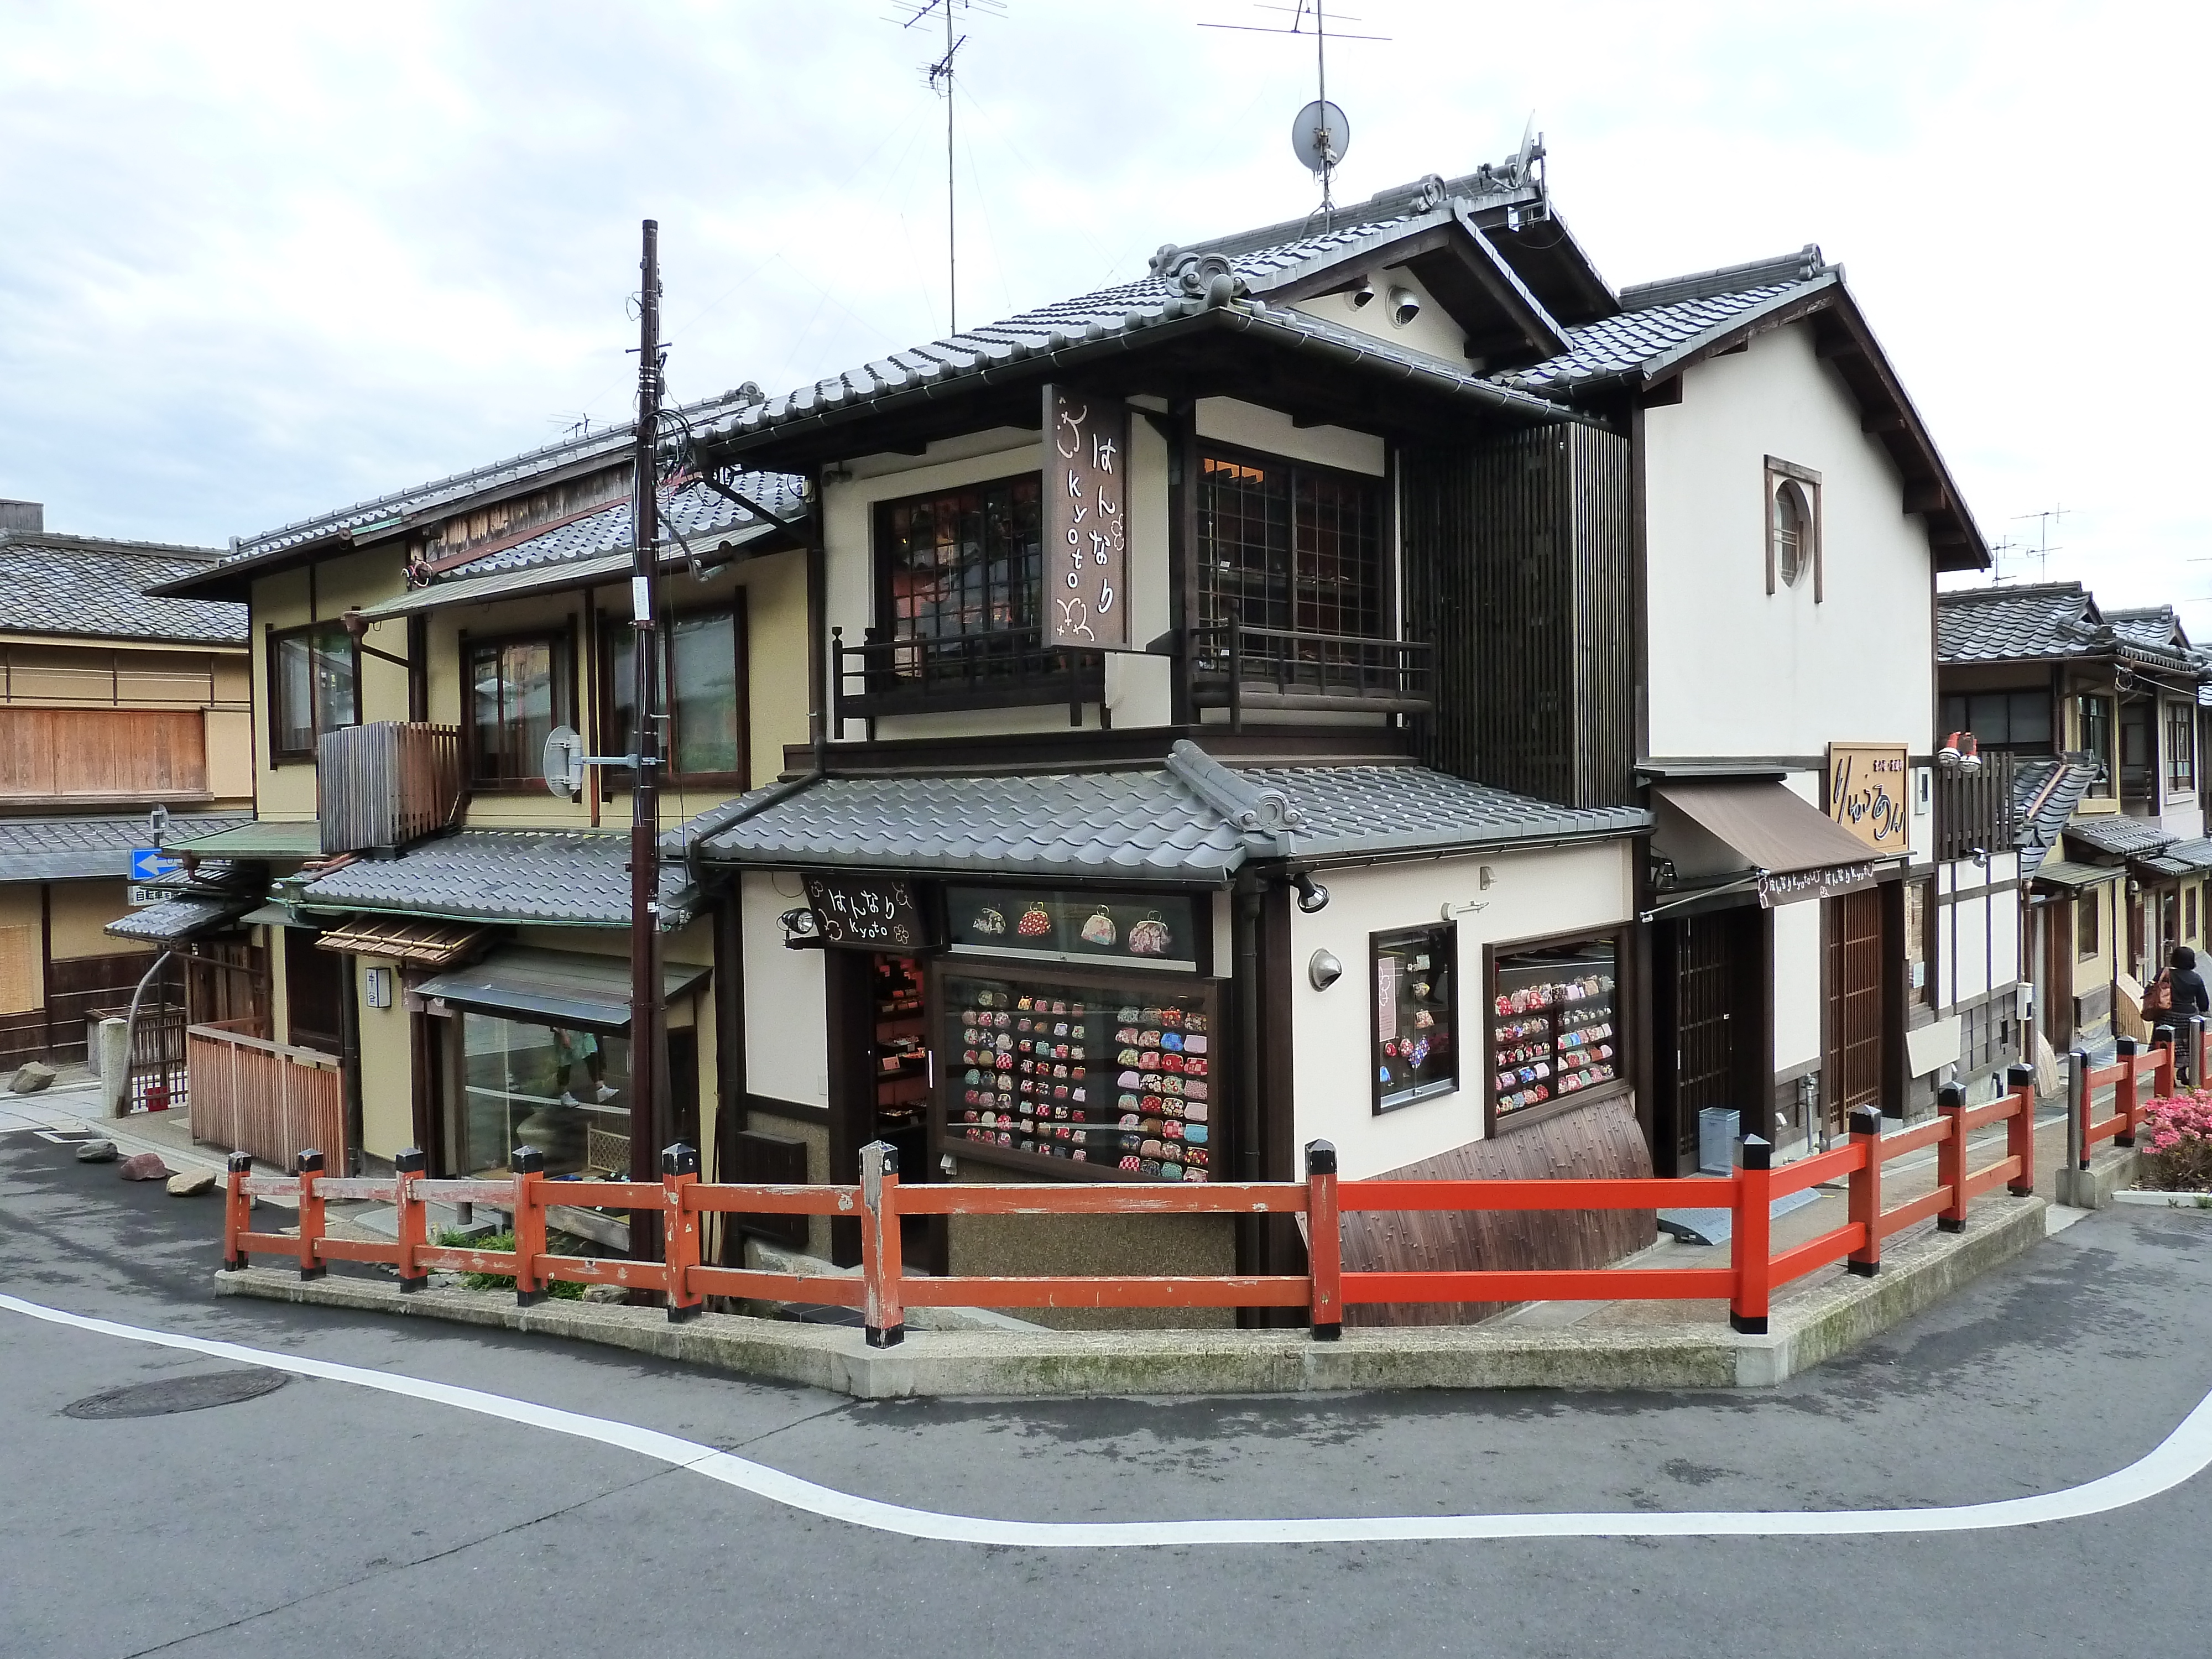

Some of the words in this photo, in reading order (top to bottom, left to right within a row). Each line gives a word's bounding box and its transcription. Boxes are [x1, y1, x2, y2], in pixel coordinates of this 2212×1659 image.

[1067, 469, 1088, 589] kyoto
[1088, 432, 1117, 614] はんなり
[1825, 867, 1850, 886] はんなり
[828, 888, 895, 920] はんなり
[849, 917, 888, 938] kyoto
